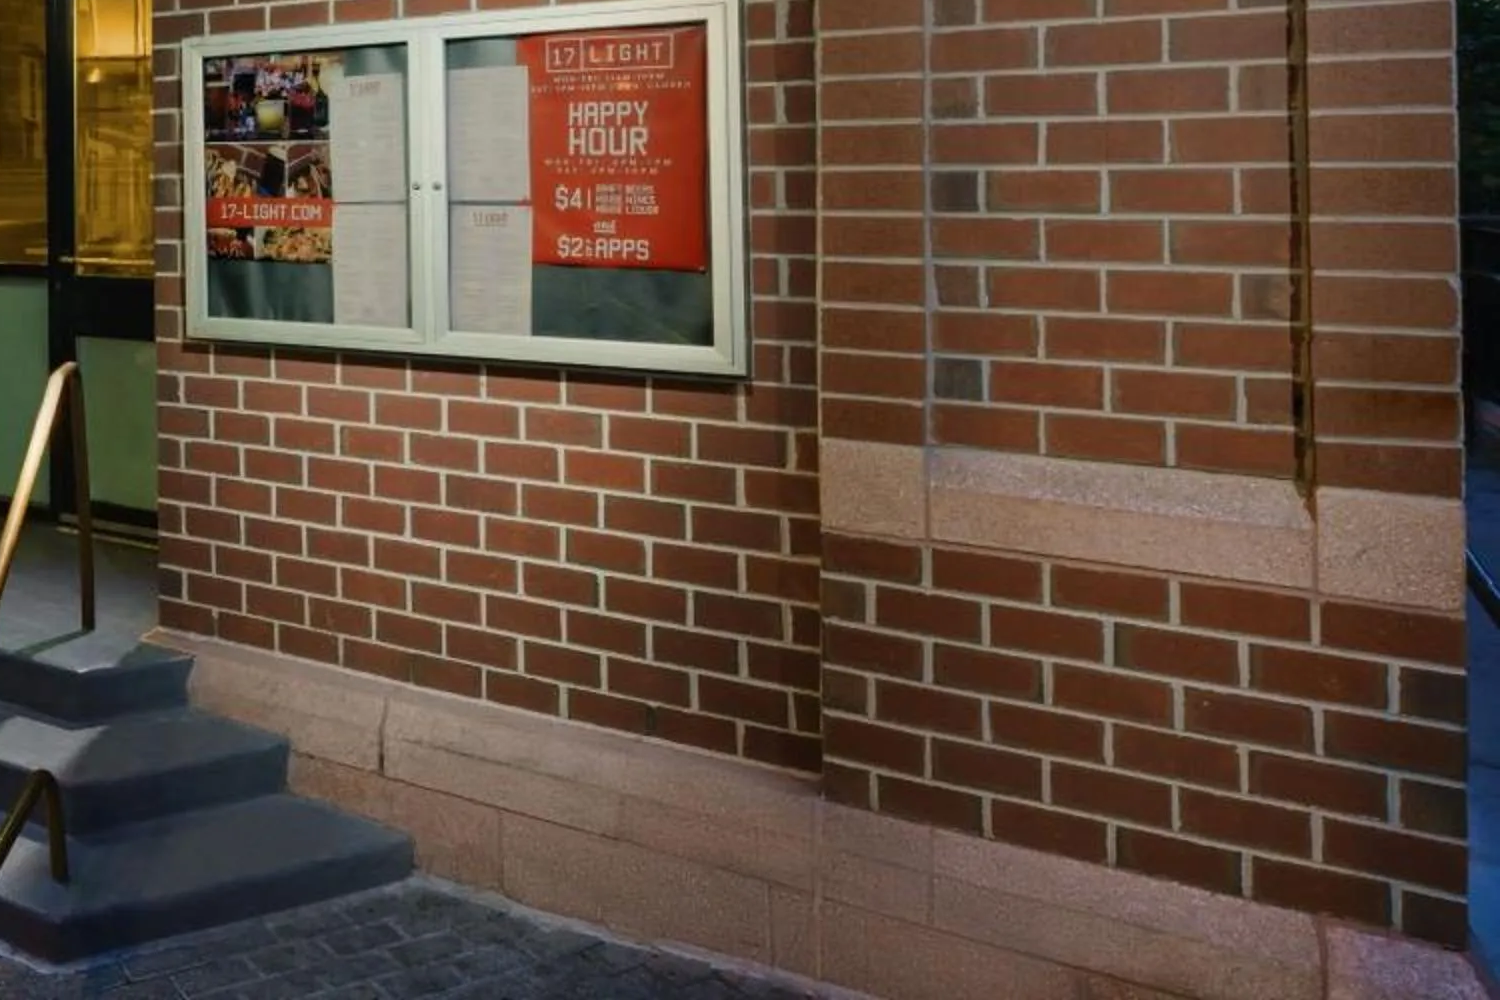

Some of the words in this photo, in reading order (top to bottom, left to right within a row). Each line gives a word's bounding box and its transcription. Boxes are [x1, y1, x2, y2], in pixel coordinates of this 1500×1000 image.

[552, 47, 576, 67] 17
[588, 42, 664, 63] LIGHT
[568, 101, 649, 127] HAPPY
[568, 127, 648, 156] HOUR
[555, 184, 582, 211] $4
[220, 203, 322, 221] 17-LIGHT.COM
[557, 234, 584, 259] $2
[595, 238, 650, 261] APPS
